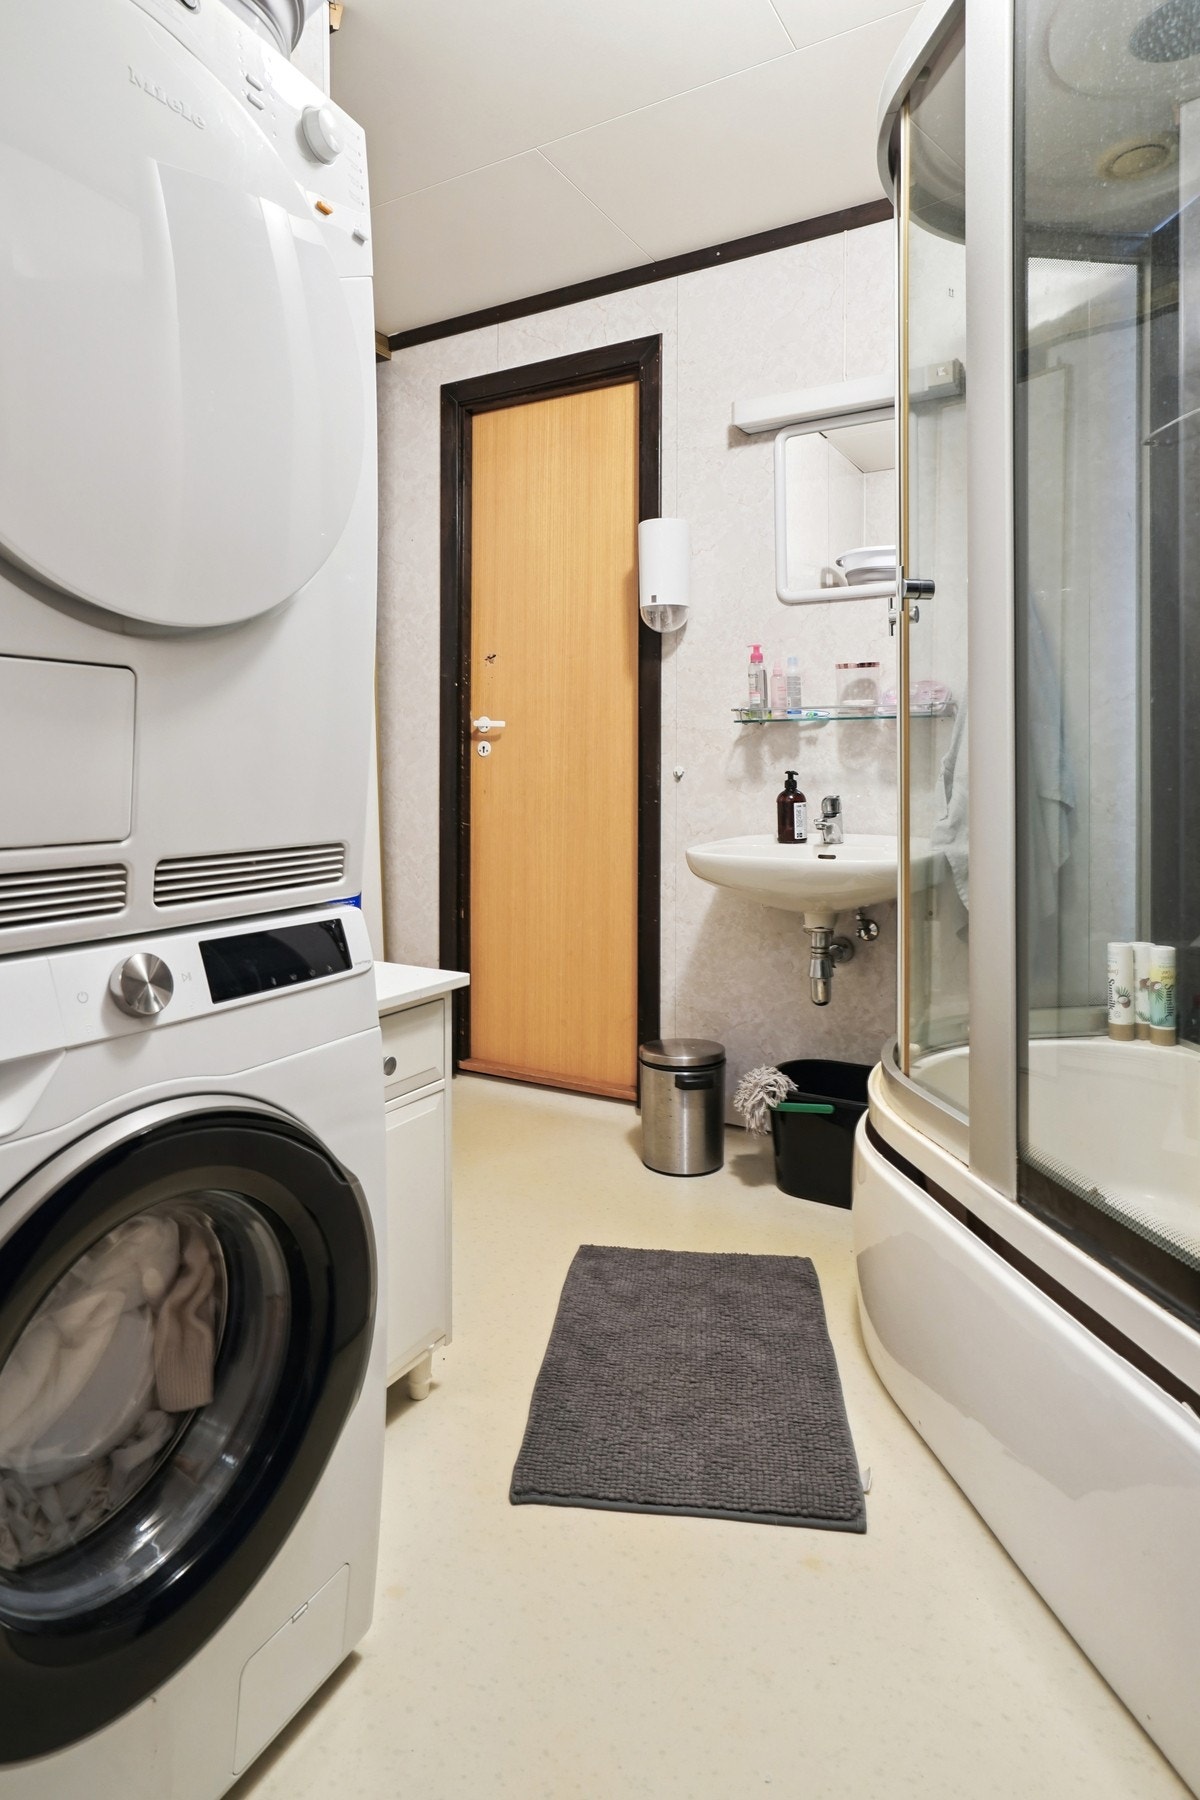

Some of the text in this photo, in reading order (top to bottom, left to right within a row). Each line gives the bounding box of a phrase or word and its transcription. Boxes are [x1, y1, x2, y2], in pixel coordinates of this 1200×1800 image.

[128, 65, 205, 130] Miele
[1108, 978, 1116, 1011] Sunsilk
[1164, 983, 1175, 1021] Sunsilk
